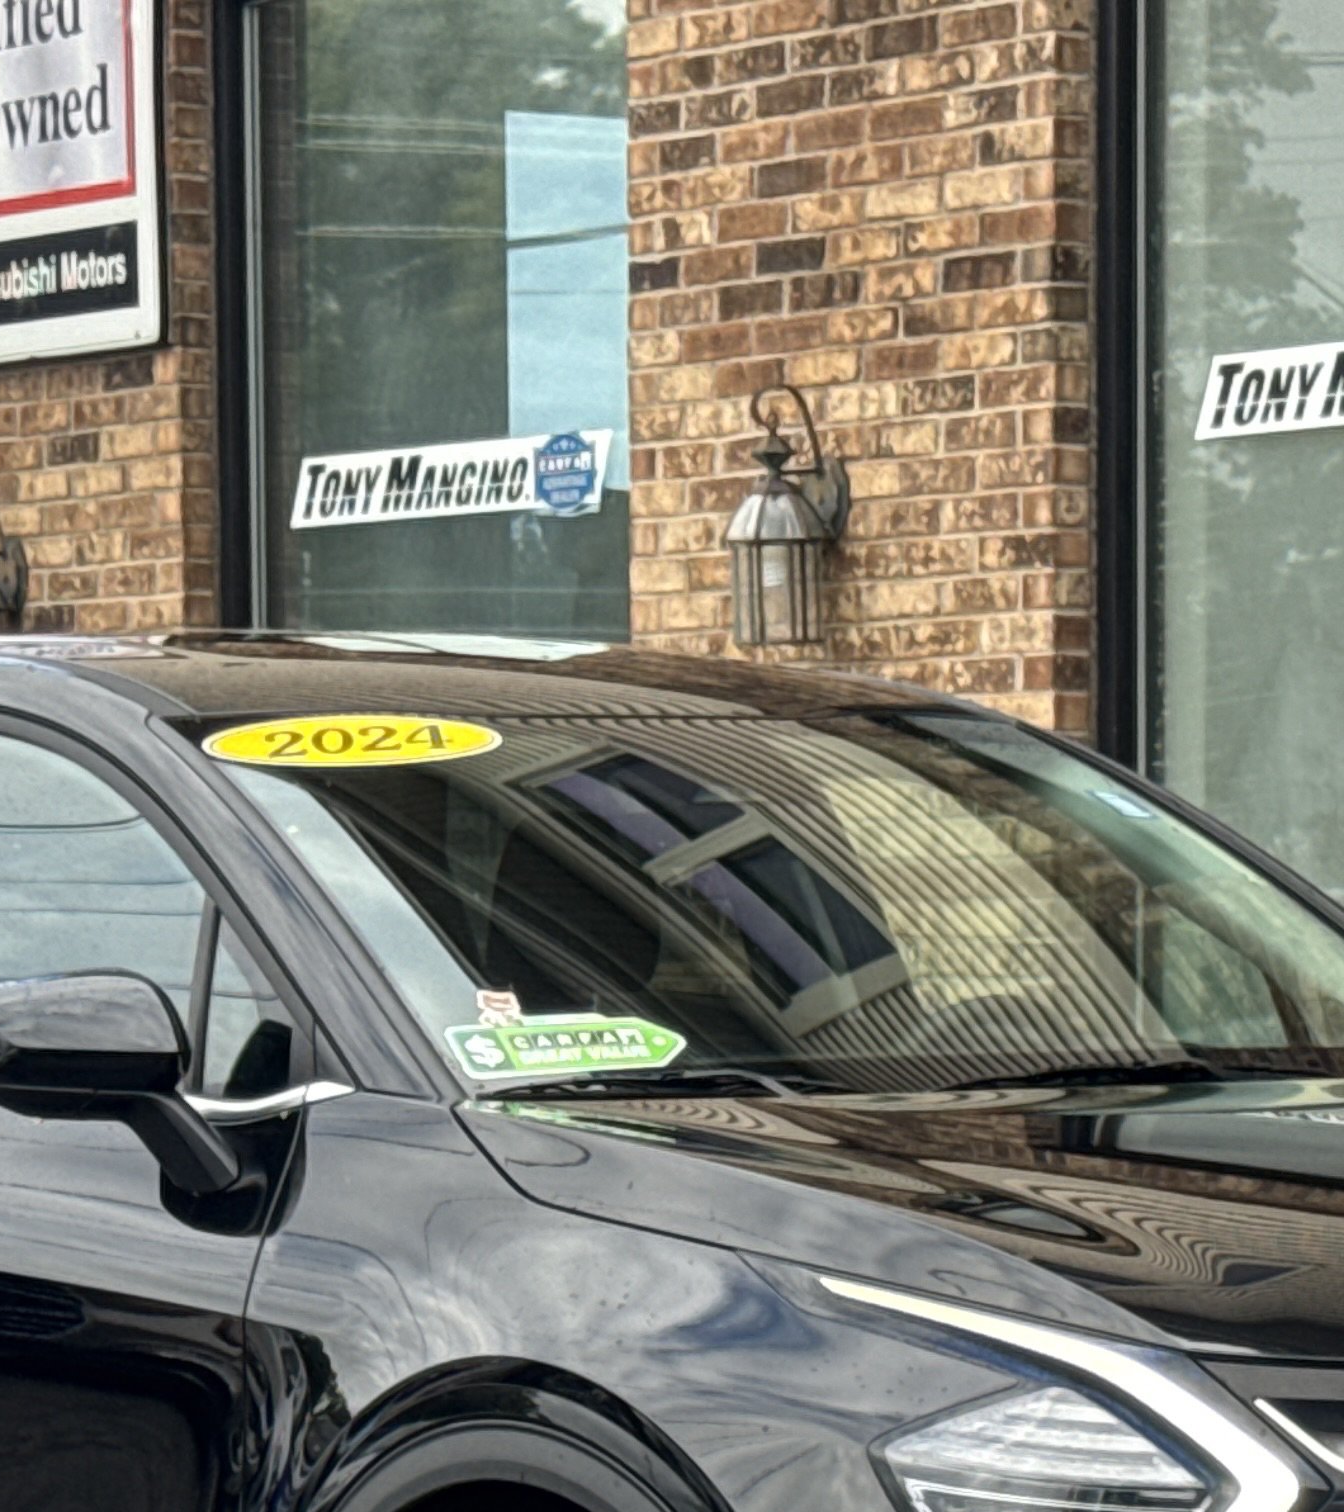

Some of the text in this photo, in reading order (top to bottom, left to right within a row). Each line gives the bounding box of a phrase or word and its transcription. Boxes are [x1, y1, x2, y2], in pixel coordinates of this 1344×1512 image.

[61, 250, 126, 293] Motors
[1211, 361, 1324, 429] TONY
[302, 463, 383, 520] TONY
[264, 725, 454, 759] 2024
